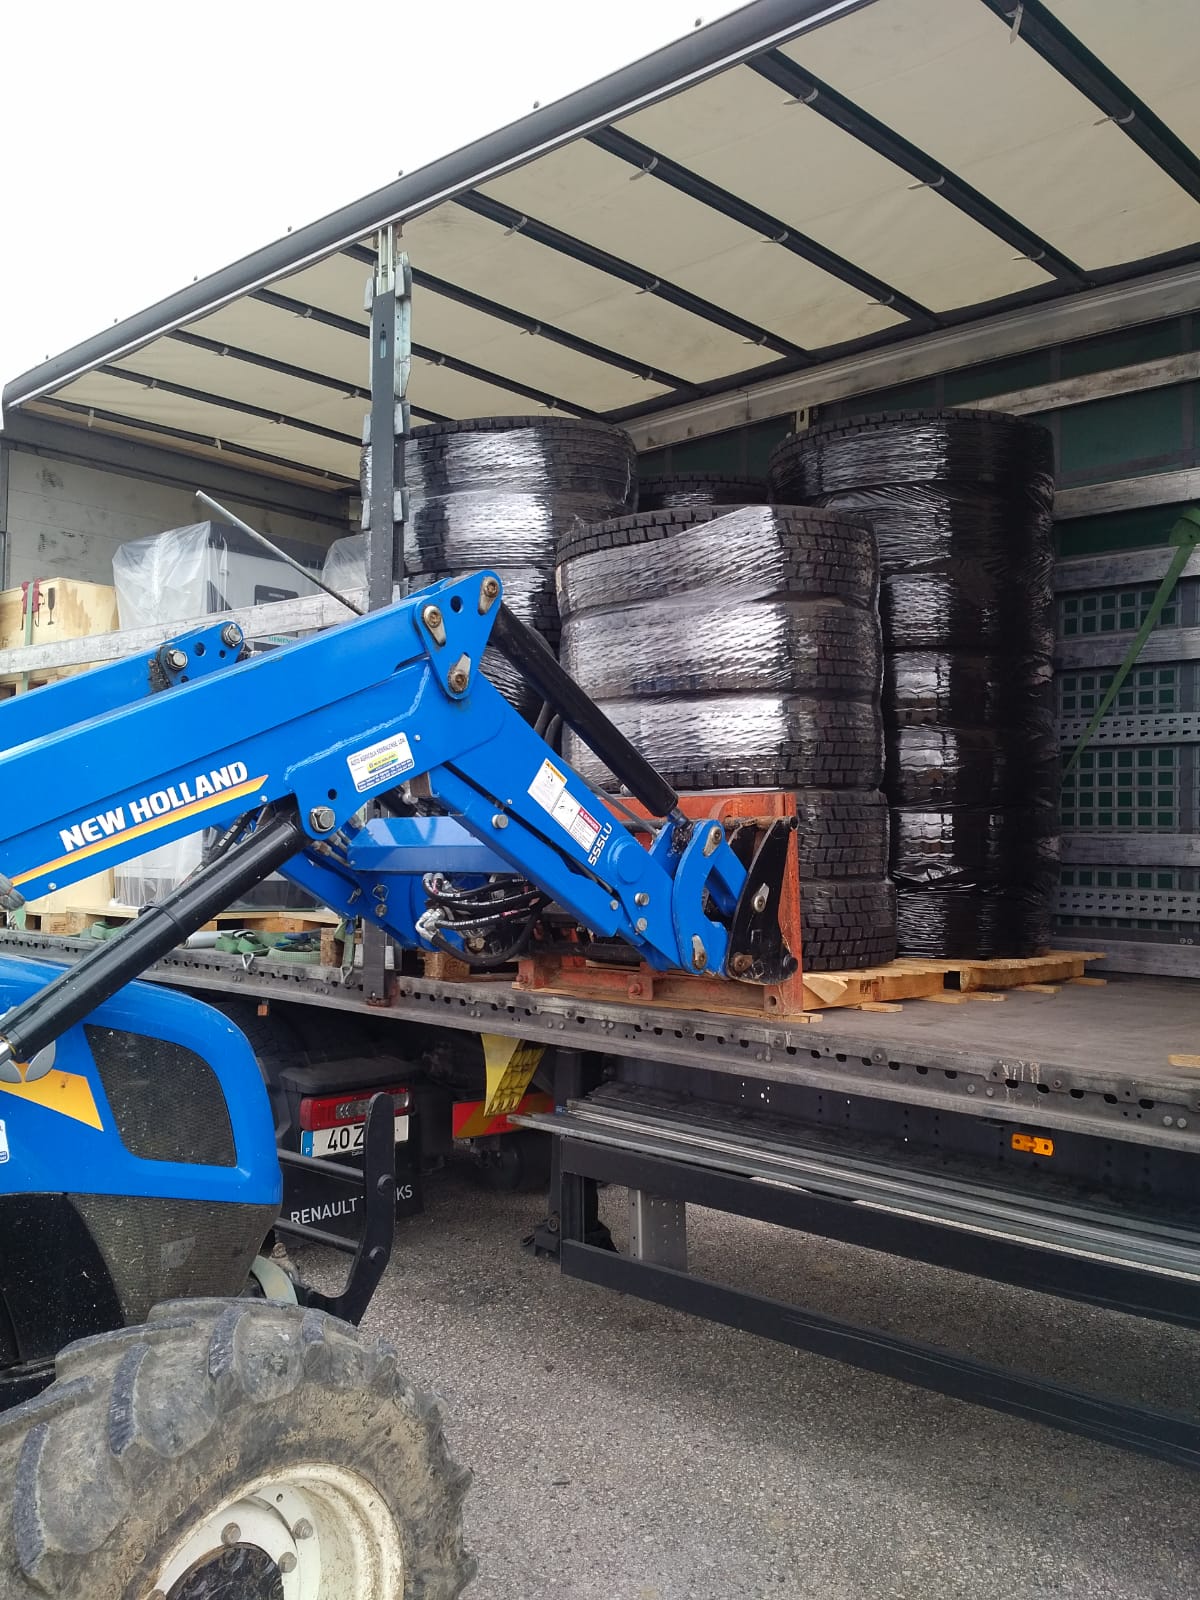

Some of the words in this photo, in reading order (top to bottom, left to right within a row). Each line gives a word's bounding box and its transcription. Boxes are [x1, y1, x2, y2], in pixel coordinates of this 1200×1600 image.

[59, 806, 126, 852] NEW
[128, 761, 248, 824] HOLLAND
[587, 822, 613, 867] 555LU
[290, 1197, 358, 1225] RENAULT
